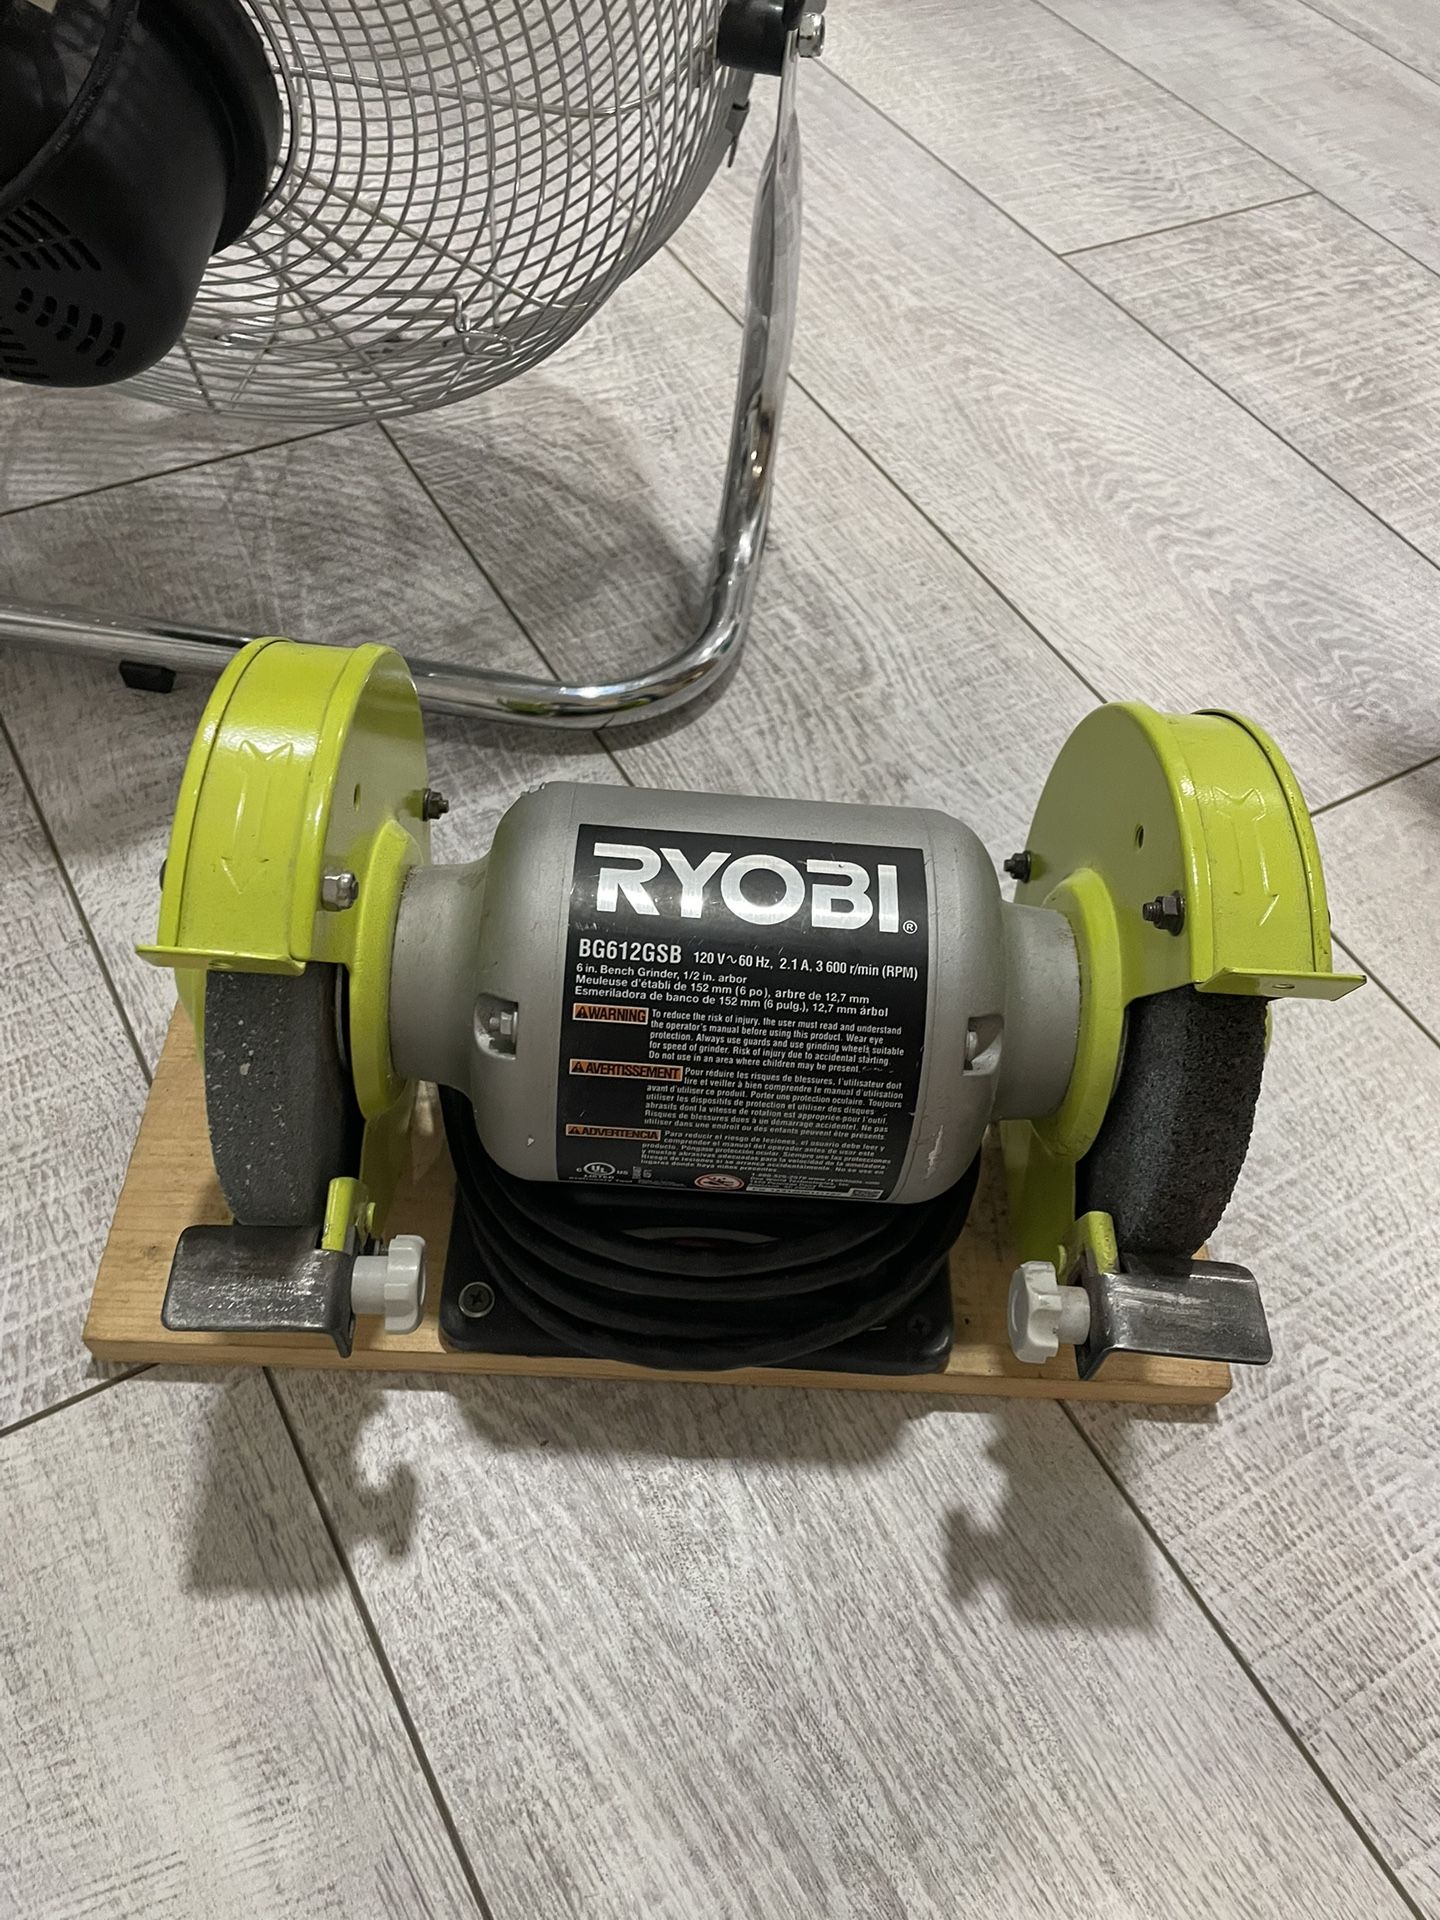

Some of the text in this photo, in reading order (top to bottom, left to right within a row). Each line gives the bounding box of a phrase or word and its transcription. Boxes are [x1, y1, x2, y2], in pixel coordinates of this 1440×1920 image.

[594, 842, 899, 933] RYOBI
[578, 938, 682, 964] BG612GSB
[694, 951, 714, 964] 120
[755, 955, 772, 970] Hz,
[779, 957, 796, 970] 2.1
[849, 962, 878, 975] r/min
[882, 964, 917, 980] (RPM)
[576, 963, 746, 984] 6 in. Bench Grinder, 1/2 in. arbor
[575, 974, 869, 1004] Meuleuse d'établi de 152 mm (6 po), arbre de 12,7 mm
[574, 986, 888, 1016] Esmeriladora de banco de 152 mm (6 pulg.), 12,7 mm árbol
[588, 1006, 646, 1022] WARNING
[651, 1009, 661, 1018] To
[663, 1010, 691, 1020] reduce
[692, 1011, 706, 1021] the
[708, 1013, 723, 1022] risk
[725, 1014, 733, 1023] of
[763, 1016, 776, 1026] the
[798, 1020, 818, 1028] must
[820, 1021, 838, 1030] read
[840, 1022, 855, 1031] and
[857, 1024, 902, 1034] understand
[650, 1019, 664, 1028] the
[665, 1022, 707, 1031] operator's
[709, 1025, 739, 1034] manual
[741, 1025, 767, 1036] before
[769, 1028, 791, 1039] using
[793, 1029, 808, 1038] this
[846, 1032, 867, 1042] Wear
[869, 1036, 883, 1045] eye
[649, 1040, 661, 1049] for
[662, 1042, 687, 1052] speed
[689, 1043, 697, 1051] of
[732, 1046, 751, 1055] Risk
[752, 1047, 760, 1056] of
[762, 1048, 786, 1059] injury
[788, 1049, 802, 1058] due
[804, 1051, 813, 1059] to
[815, 1052, 856, 1062] accidental
[696, 1033, 725, 1045] Always
[743, 1037, 771, 1047] guards
[772, 1038, 788, 1047] and
[806, 1040, 840, 1053] grinding
[872, 1045, 904, 1055] suitable
[586, 1062, 680, 1079] AVERTISSEMENT
[648, 1050, 660, 1059] Do
[662, 1052, 675, 1060] not
[693, 1053, 701, 1062] in
[735, 1056, 760, 1065] where
[762, 1058, 795, 1068] children
[797, 1062, 814, 1071] may
[816, 1061, 826, 1070] be
[684, 1067, 704, 1076] Pour
[705, 1068, 735, 1078] réduire
[736, 1070, 750, 1079] les
[750, 1071, 781, 1082] risques
[782, 1073, 793, 1082] de
[886, 1080, 902, 1089] doit
[684, 1076, 698, 1085] lire
[700, 1078, 708, 1086] et
[709, 1079, 736, 1088] veiller
[744, 1080, 763, 1089] bien
[764, 1084, 812, 1092] comprendre
[814, 1085, 822, 1093] le
[824, 1087, 854, 1095] manual
[646, 1093, 675, 1102] utiliser
[676, 1094, 689, 1102] les
[690, 1095, 732, 1105] dispositifs
[734, 1098, 744, 1106] de
[745, 1099, 786, 1109] protection
[797, 1102, 826, 1111] utiliser
[828, 1104, 842, 1112] des
[843, 1105, 875, 1115] disques
[750, 1090, 775, 1099] Porter
[792, 1093, 831, 1103] protection
[868, 1098, 903, 1108] Toujours
[582, 1128, 658, 1139] ADVERTENCIA
